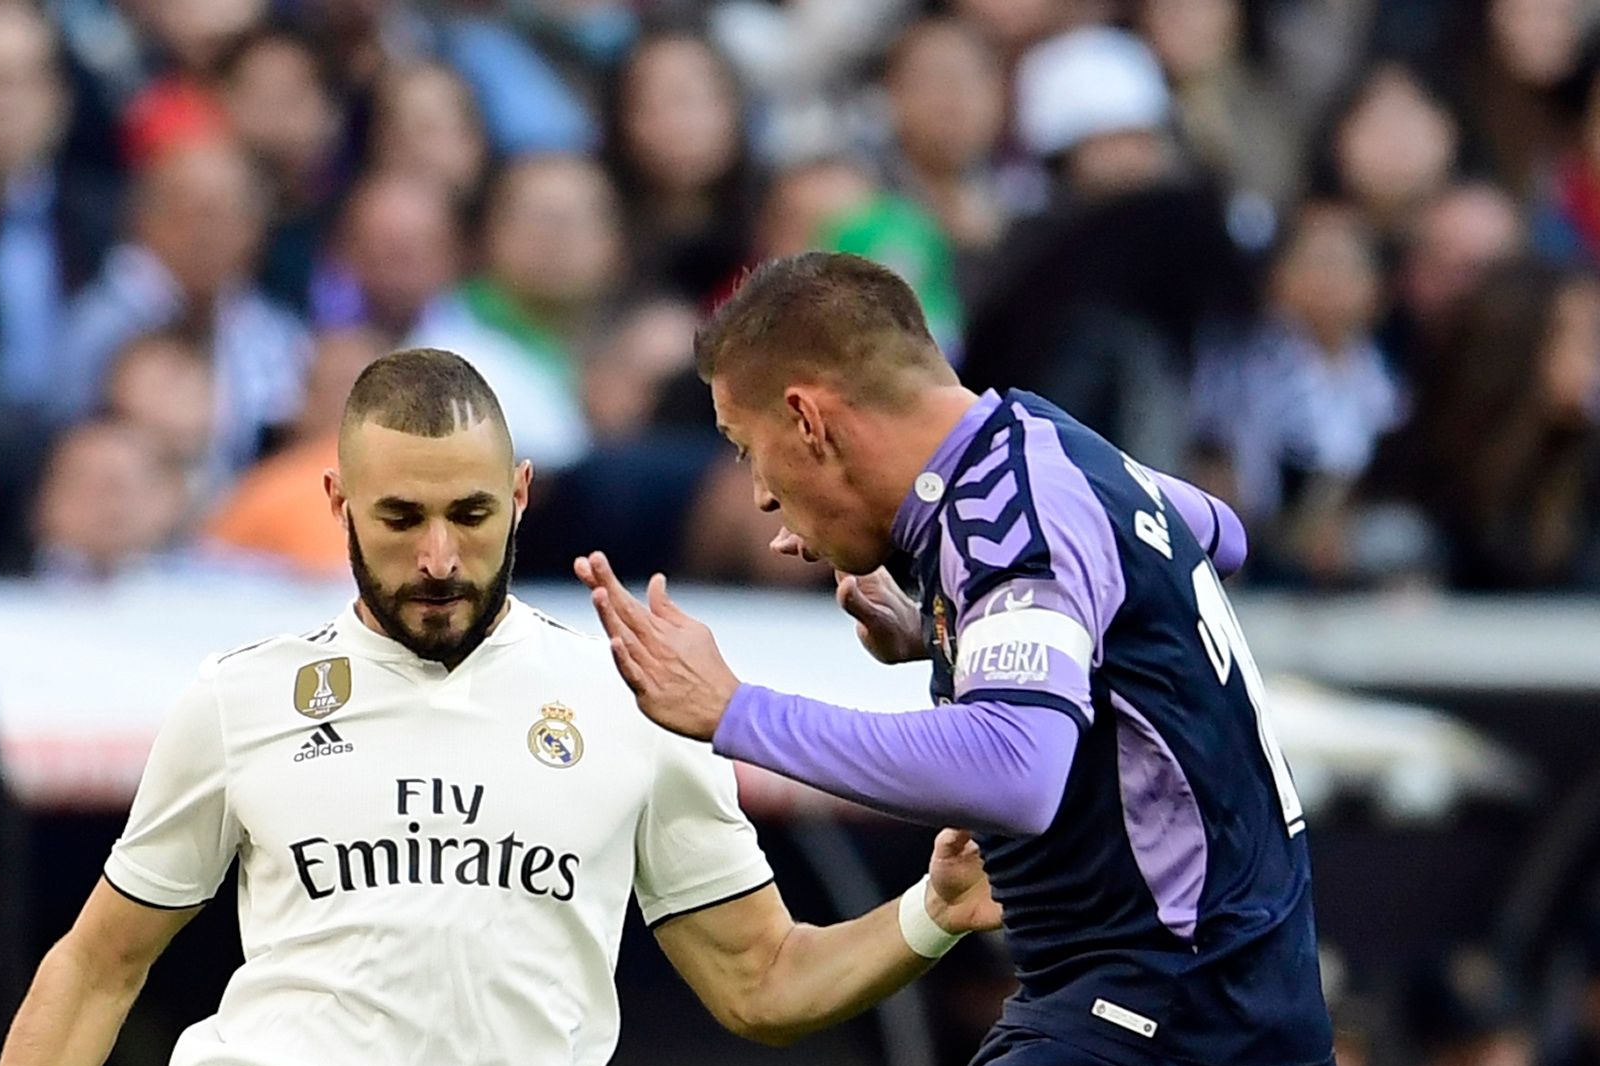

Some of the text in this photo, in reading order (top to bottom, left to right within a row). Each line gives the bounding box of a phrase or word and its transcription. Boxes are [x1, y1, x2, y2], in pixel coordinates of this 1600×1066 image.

[957, 640, 1049, 681] NTEGRA
[308, 695, 337, 709] FIFA
[293, 742, 354, 762] adidas
[395, 778, 484, 824] Fly
[289, 821, 580, 901] Emirates
